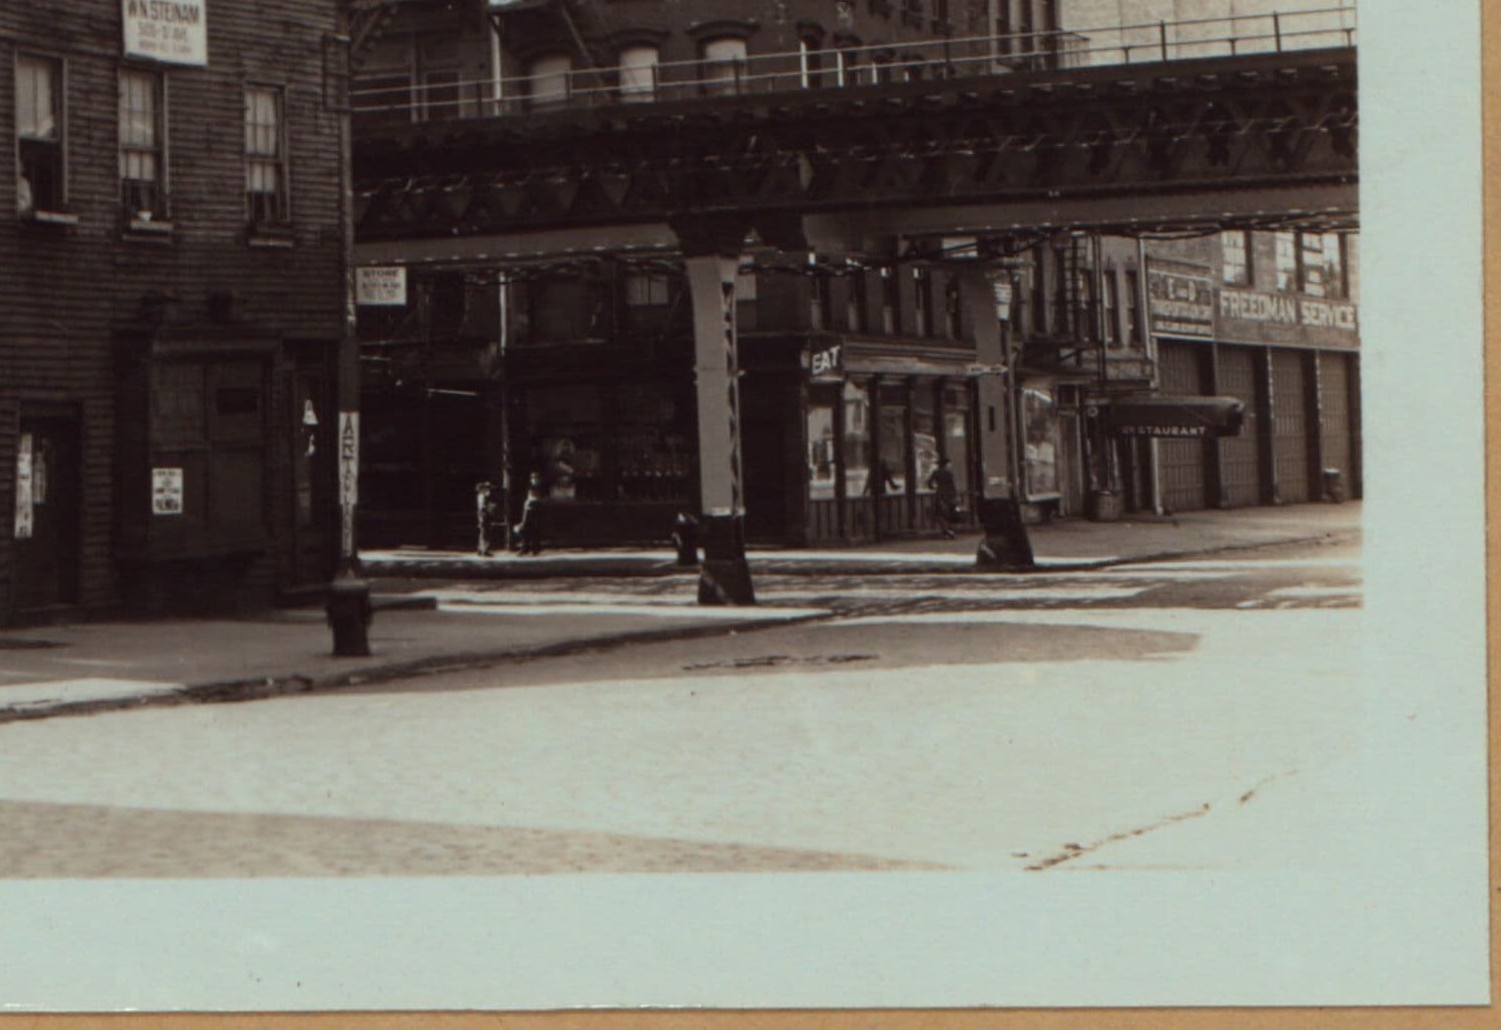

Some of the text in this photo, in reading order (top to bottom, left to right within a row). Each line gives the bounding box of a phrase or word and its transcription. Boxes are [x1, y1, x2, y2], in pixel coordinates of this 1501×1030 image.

[1219, 290, 1297, 323] FREEDMAN
[1301, 300, 1357, 330] SERVICE
[812, 345, 841, 375] EAT
[1122, 425, 1206, 435] RESTAURANT
